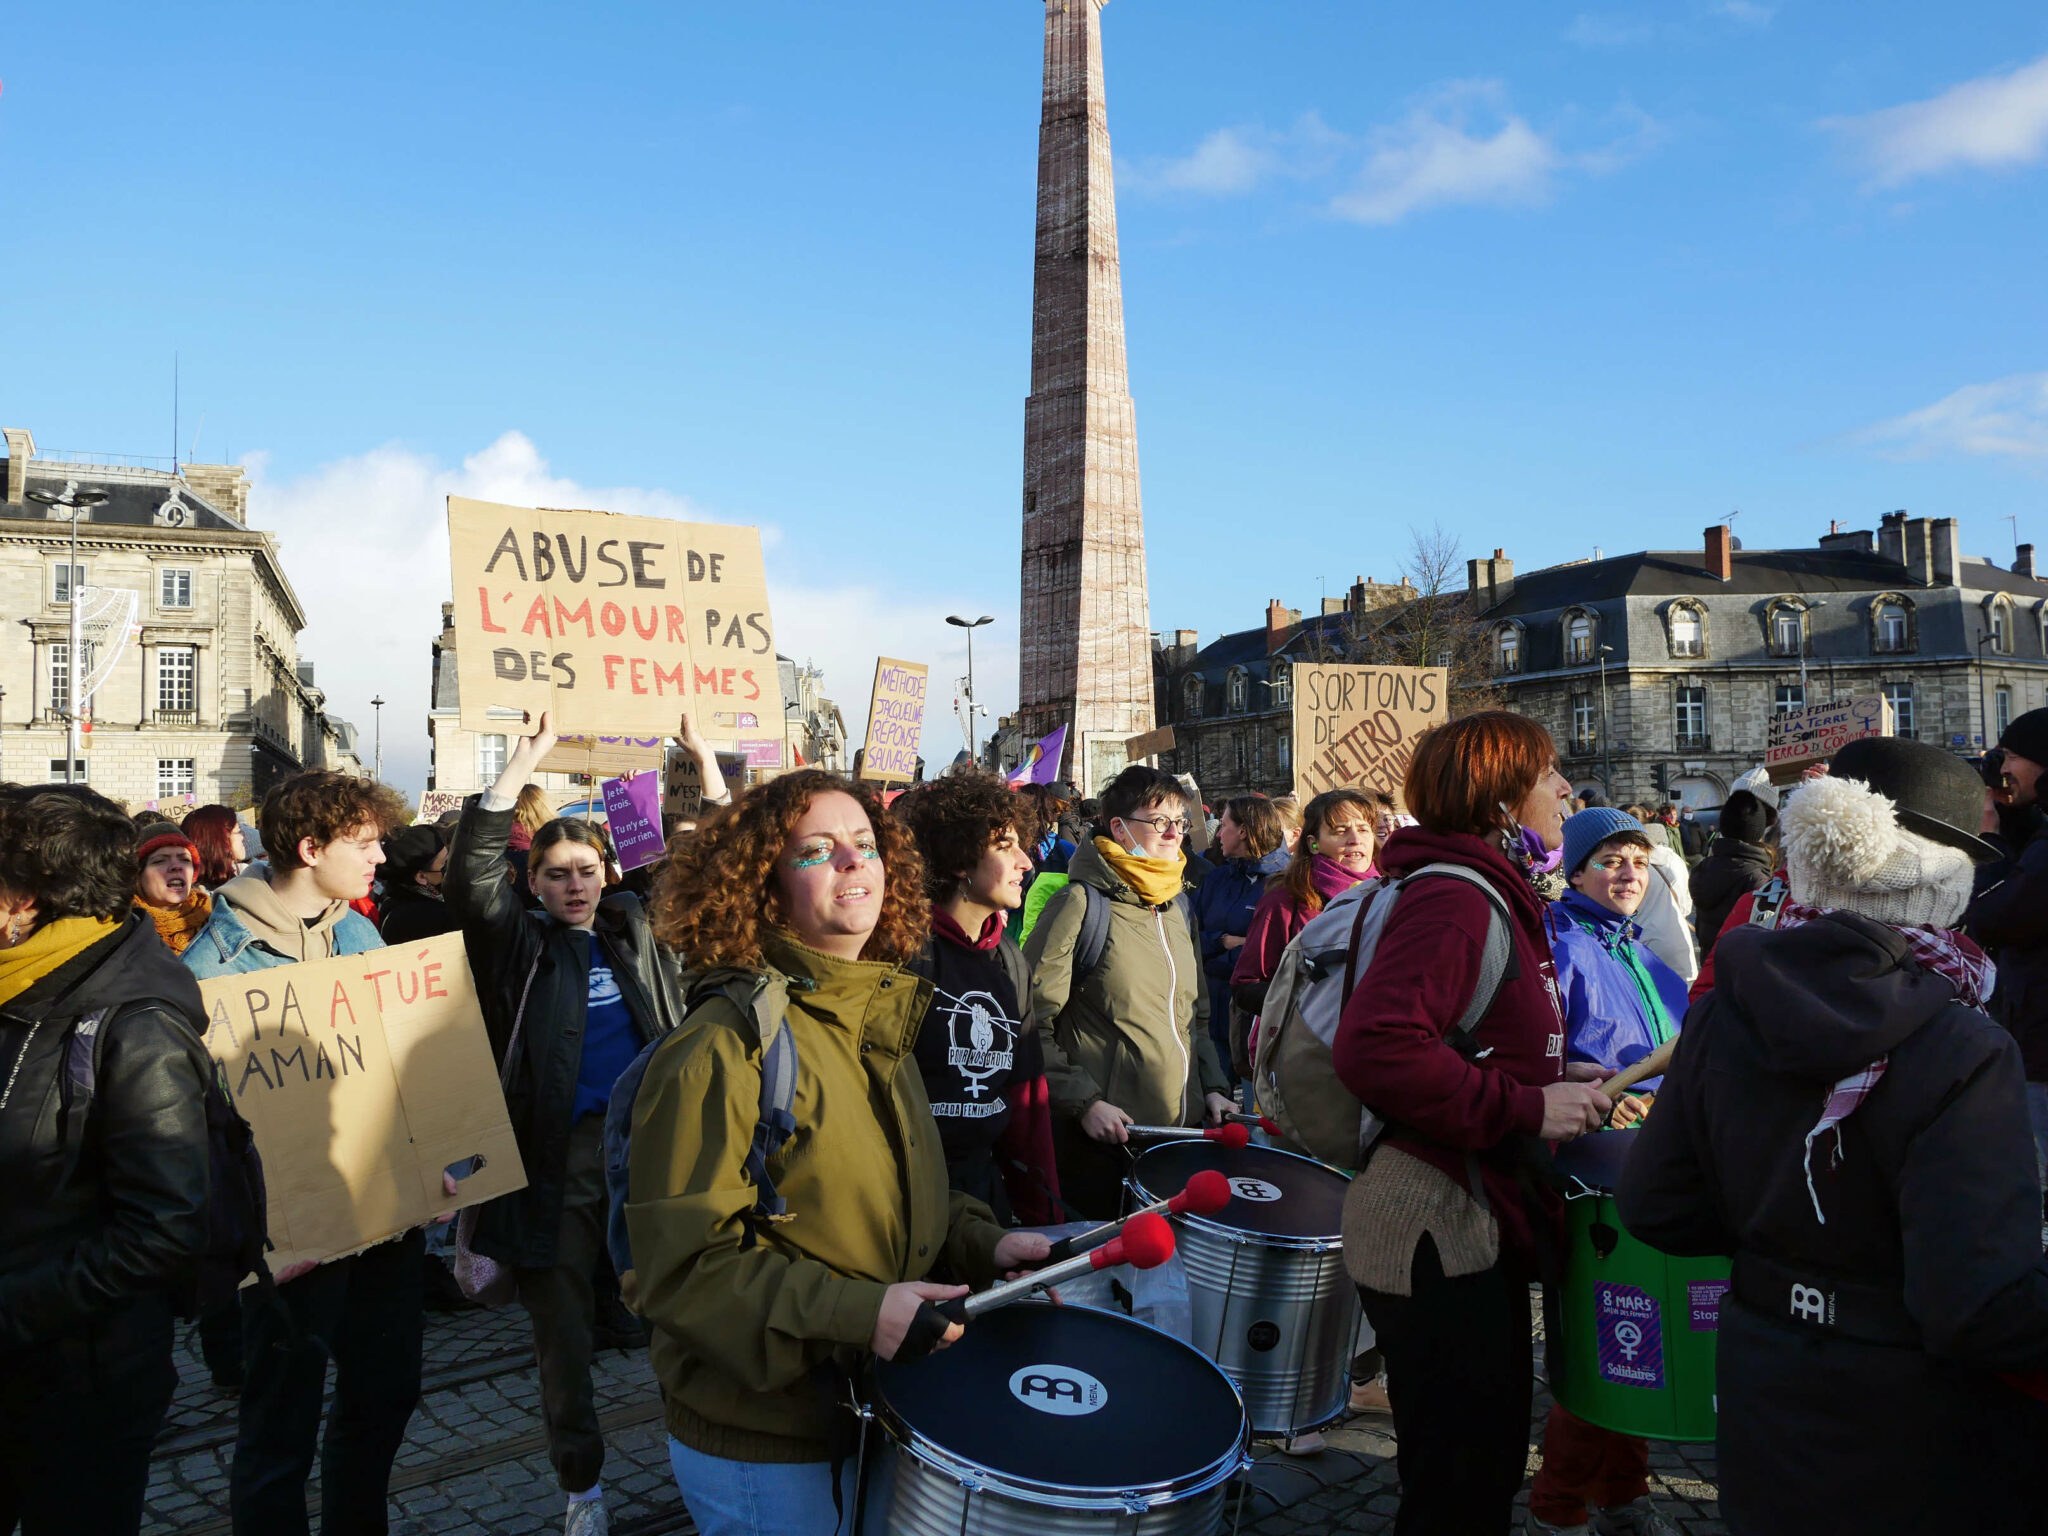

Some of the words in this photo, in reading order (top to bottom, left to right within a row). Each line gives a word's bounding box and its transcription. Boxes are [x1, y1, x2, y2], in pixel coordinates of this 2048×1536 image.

[484, 526, 666, 590] ABUSE
[687, 549, 725, 584] DE
[478, 586, 686, 644] L'AMOUR
[706, 609, 772, 655] PAS
[493, 647, 576, 689] DES
[602, 655, 761, 701] FEMMES
[880, 665, 927, 700] MÉTHODE
[1308, 670, 1438, 714] SORTONS
[1768, 713, 1781, 725] NI
[1783, 710, 1803, 721] LES
[1807, 699, 1852, 716] FEMMES
[871, 718, 921, 751] RÉPONSE
[1314, 715, 1340, 746] DE
[1768, 725, 1780, 736] NI
[1785, 722, 1804, 732] LA
[1808, 713, 1849, 728] TERRE
[1768, 736, 1786, 747] NE
[1819, 724, 1848, 737] DES
[868, 746, 918, 776] SAUVAGE
[1766, 743, 1809, 762] TERRES
[675, 761, 698, 776] MA
[720, 762, 741, 777] NUE
[425, 793, 463, 808] MARRE
[607, 789, 616, 800] Je
[616, 786, 624, 796] te
[158, 803, 195, 817] ICIDES
[609, 799, 632, 812] crois.
[614, 825, 625, 835] Tu
[626, 822, 637, 831] n'y
[639, 818, 649, 826] es
[618, 836, 637, 850] pour
[637, 830, 655, 842] rien.
[207, 980, 309, 1050] APA
[330, 979, 357, 1028] A
[363, 948, 448, 1013] TUÉ
[950, 1049, 969, 1064] POUR
[968, 1051, 985, 1065] NOS
[986, 1052, 1012, 1068] DROITS
[931, 1104, 961, 1116] TUCADA
[1603, 1290, 1612, 1307] 8
[1615, 1295, 1652, 1312] MARS
[1828, 1291, 1836, 1326] MEINL
[1607, 1362, 1657, 1382] Solidaires
[1089, 1383, 1098, 1407] MEINL
